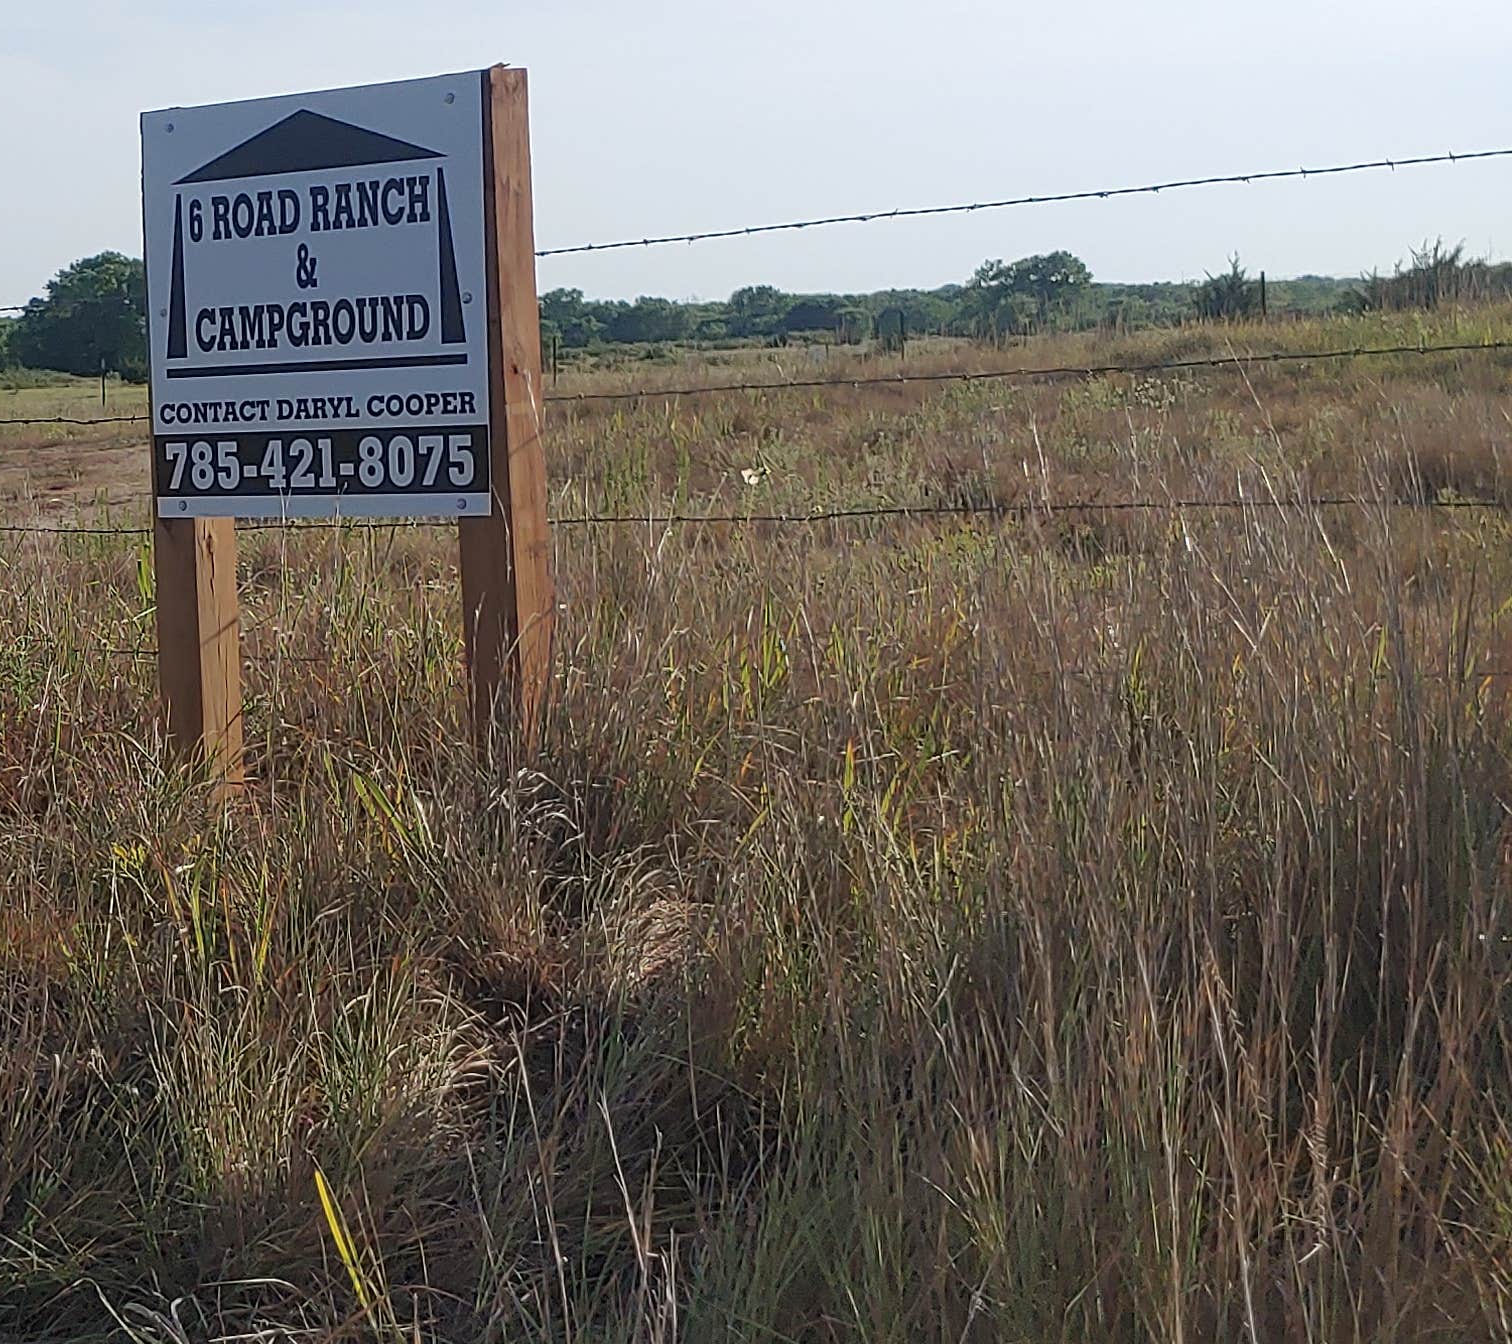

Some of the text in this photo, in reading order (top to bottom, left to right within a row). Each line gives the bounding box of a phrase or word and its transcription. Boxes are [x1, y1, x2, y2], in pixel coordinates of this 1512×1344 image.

[189, 175, 431, 243] 6 ROAD RANCH
[295, 242, 318, 289] &
[195, 293, 431, 352] CAMPGROUND
[159, 391, 477, 425] CONTACT DARYL COOPER
[166, 434, 475, 491] 785-421-8075
